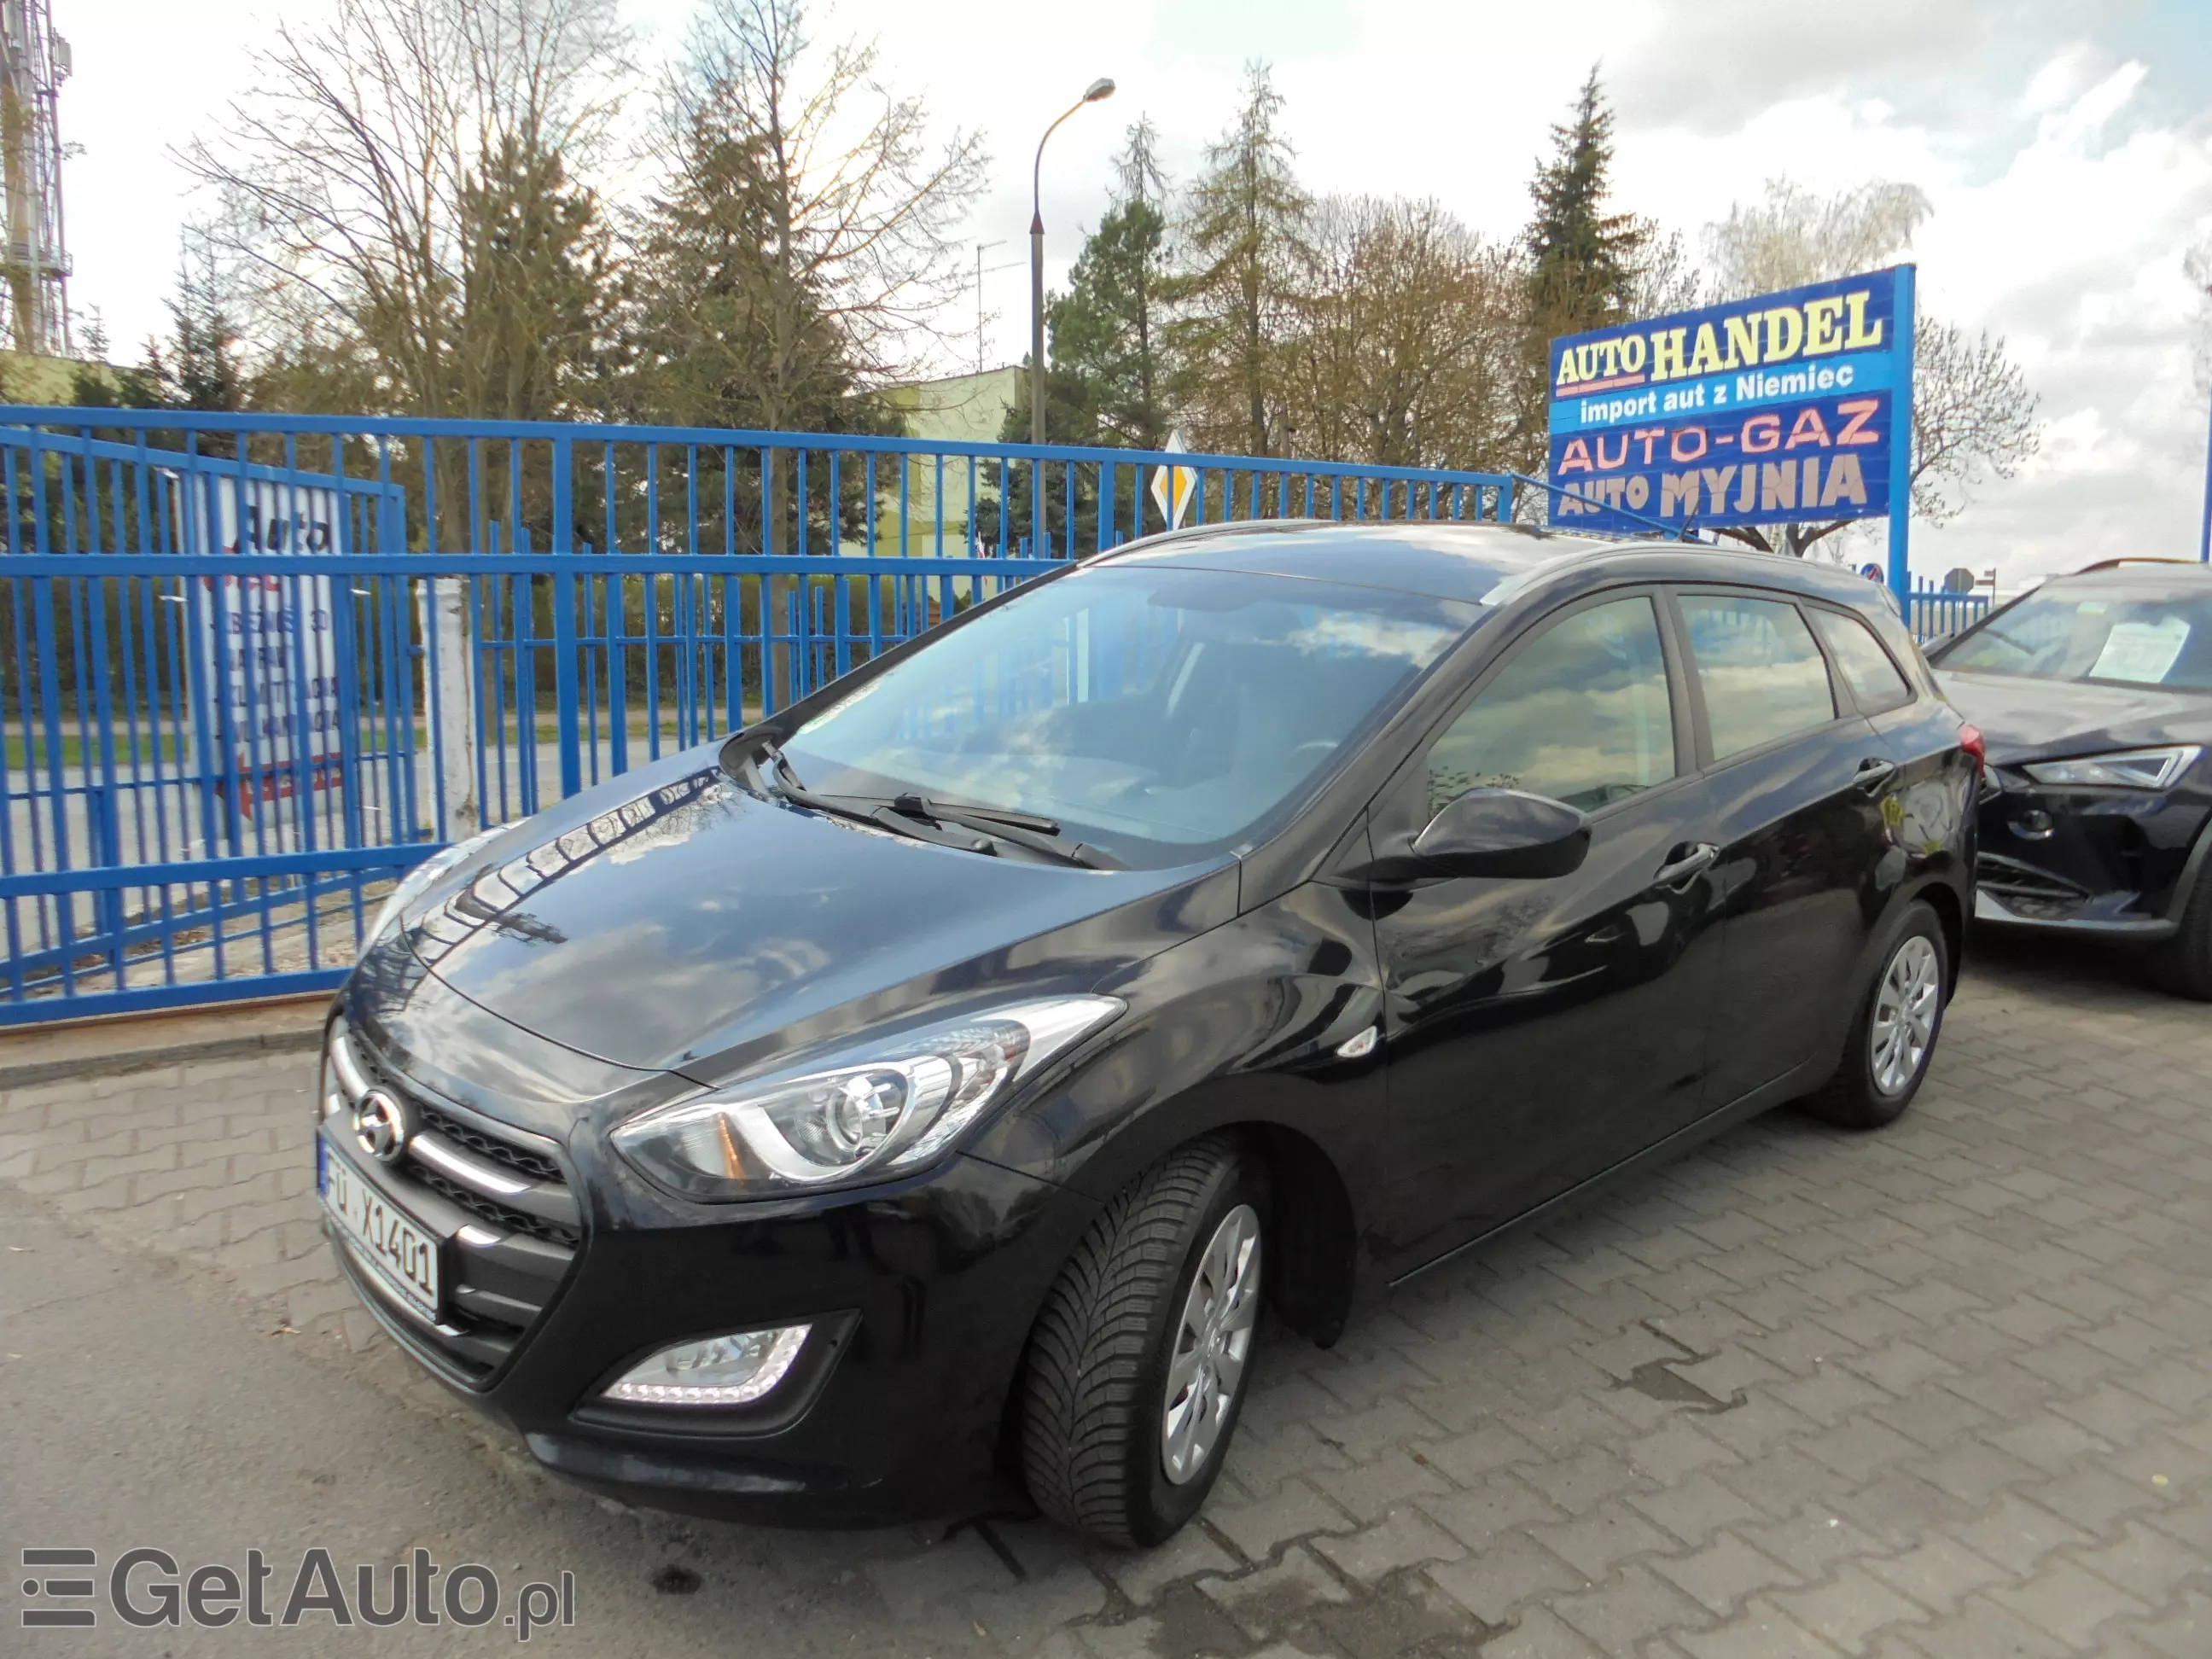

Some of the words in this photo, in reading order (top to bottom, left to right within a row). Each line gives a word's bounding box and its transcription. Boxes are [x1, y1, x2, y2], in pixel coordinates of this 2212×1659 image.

[1556, 334, 1646, 386] AUTO
[1650, 291, 1883, 382] HANDEL
[1580, 389, 1657, 423] import
[1663, 388, 1705, 411] aut
[1714, 383, 1727, 405] z
[1736, 363, 1854, 402] Niemiec
[1557, 399, 1881, 476] AUTO-GAZ
[1557, 474, 1650, 517] AUTO
[1660, 452, 1868, 518] MYJNIA
